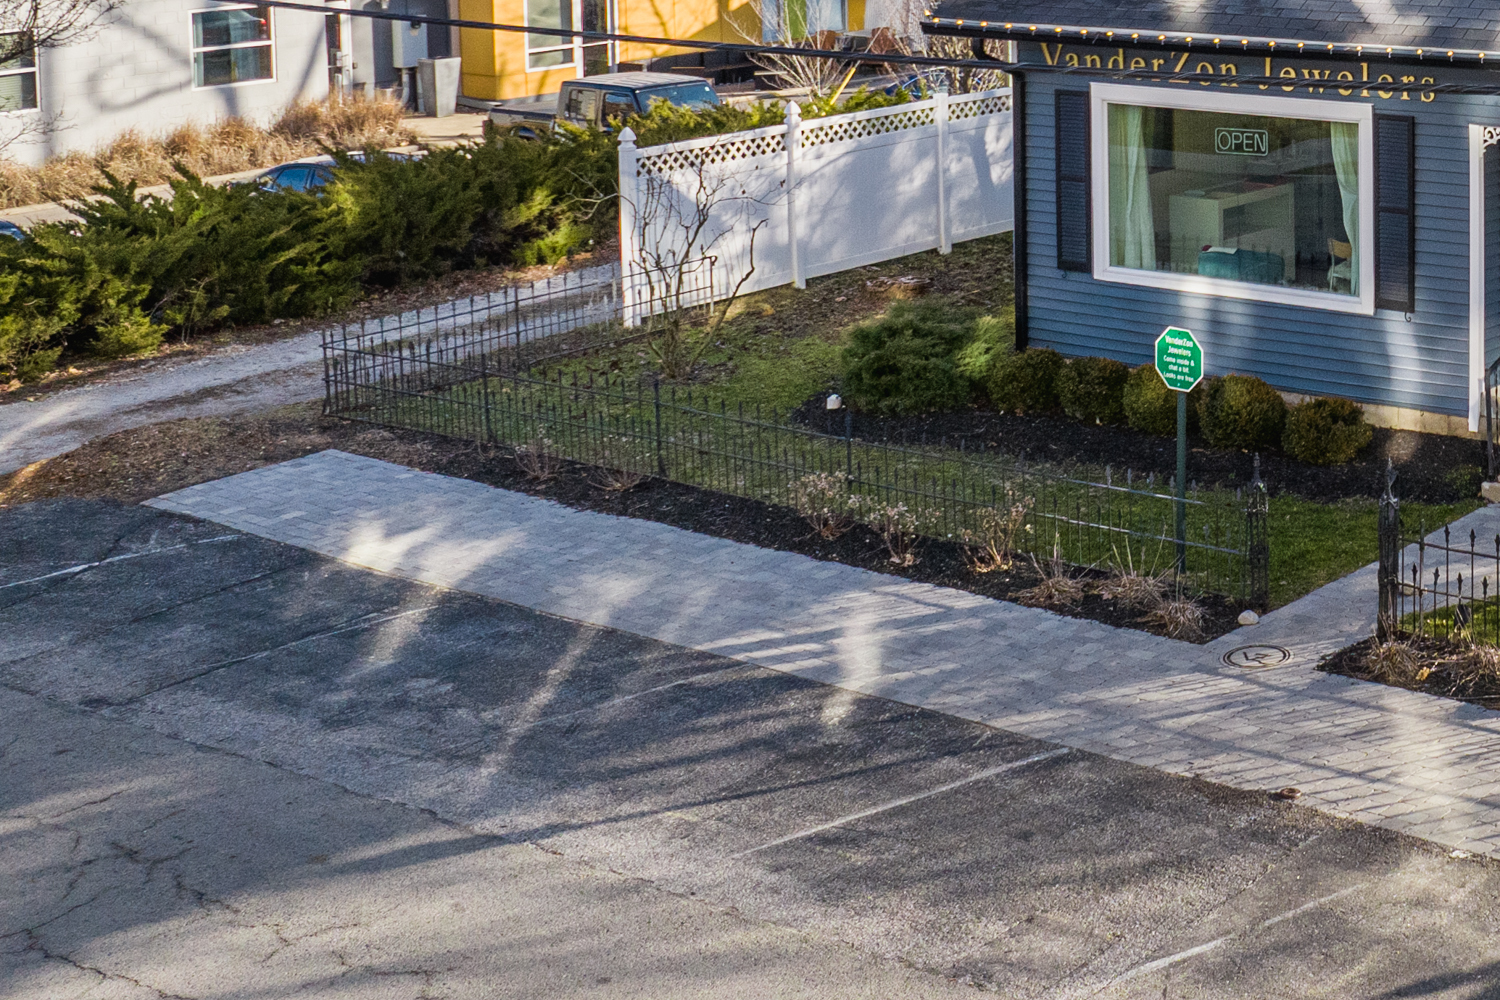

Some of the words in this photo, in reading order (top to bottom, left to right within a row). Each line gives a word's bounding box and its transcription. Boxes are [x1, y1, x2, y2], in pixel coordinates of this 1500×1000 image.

[1040, 42, 1240, 88] VanderZon
[1258, 57, 1436, 103] Jewelers
[1218, 131, 1266, 152] OPEN
[1163, 355, 1176, 363] Come
[1168, 346, 1191, 357] Jewelers
